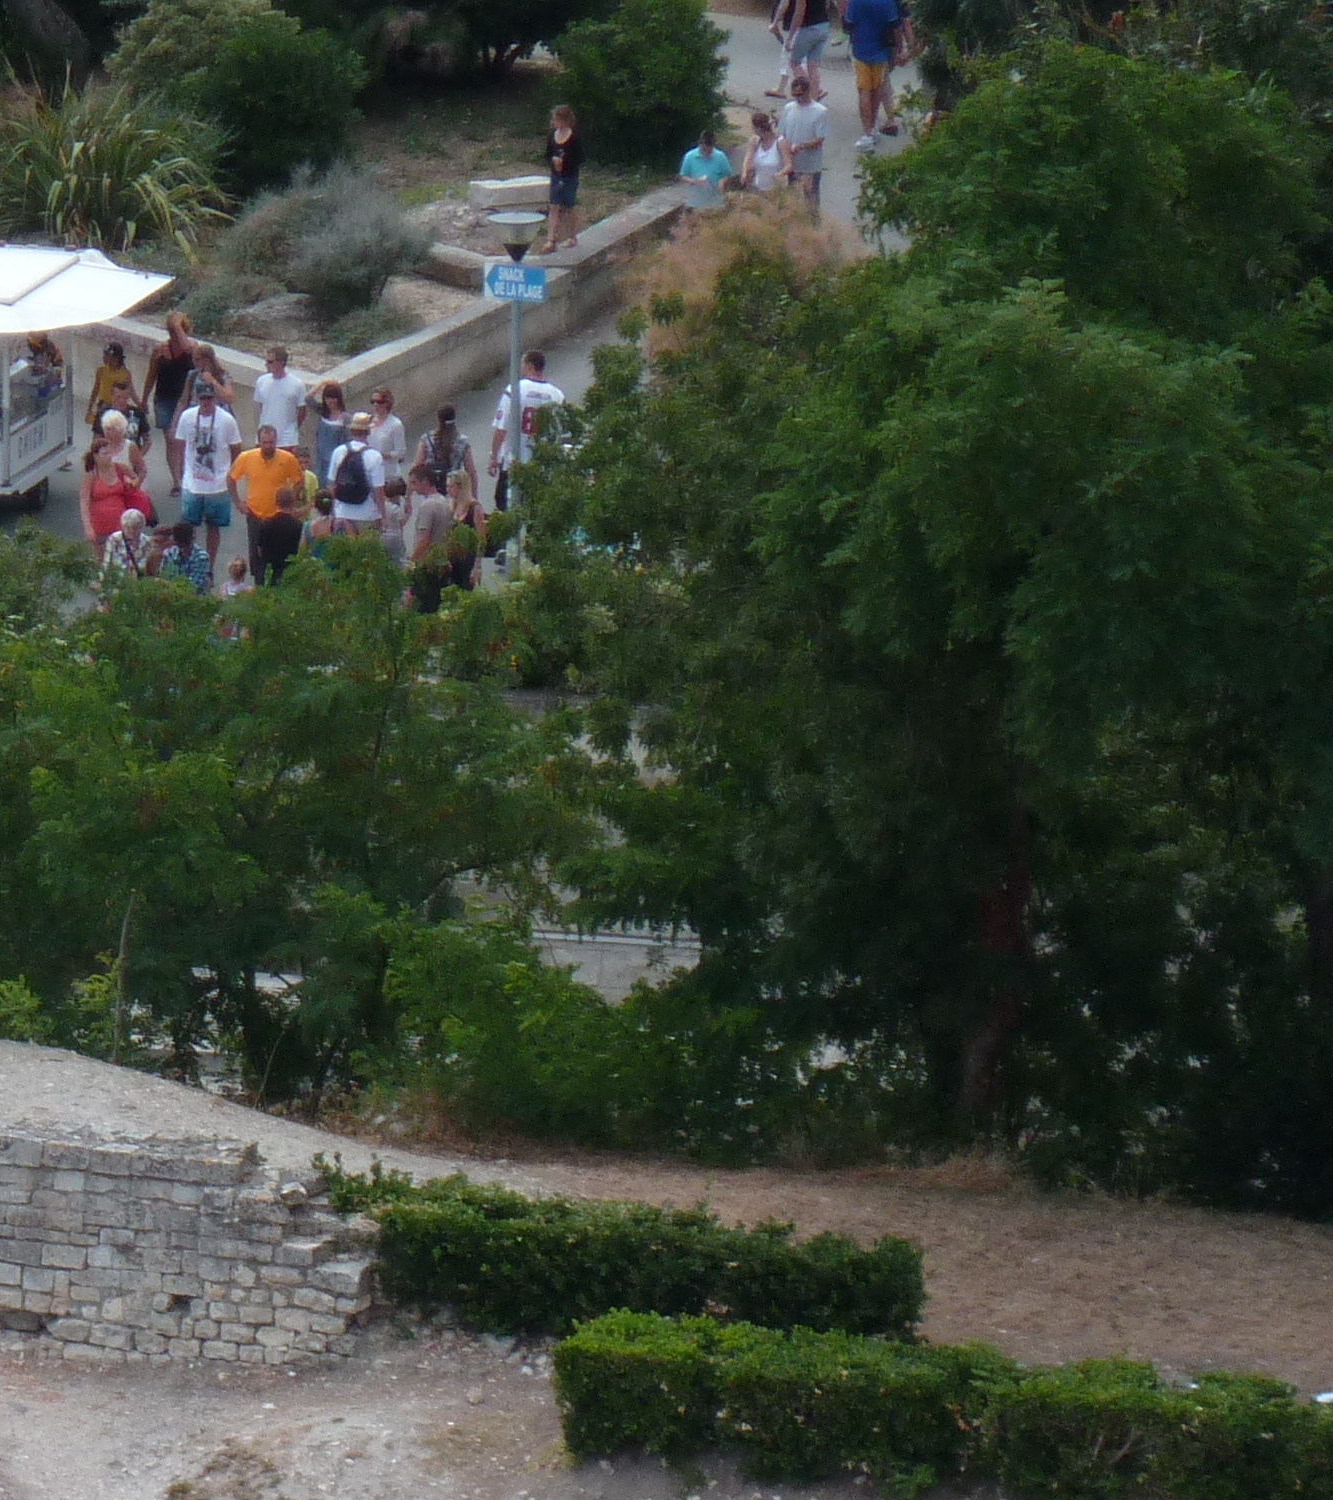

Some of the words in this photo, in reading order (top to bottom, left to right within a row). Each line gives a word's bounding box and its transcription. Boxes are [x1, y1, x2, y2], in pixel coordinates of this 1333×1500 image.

[498, 266, 524, 281] SNACK
[494, 281, 505, 296] DE
[506, 282, 517, 297] LA
[518, 283, 544, 299] PLAGE
